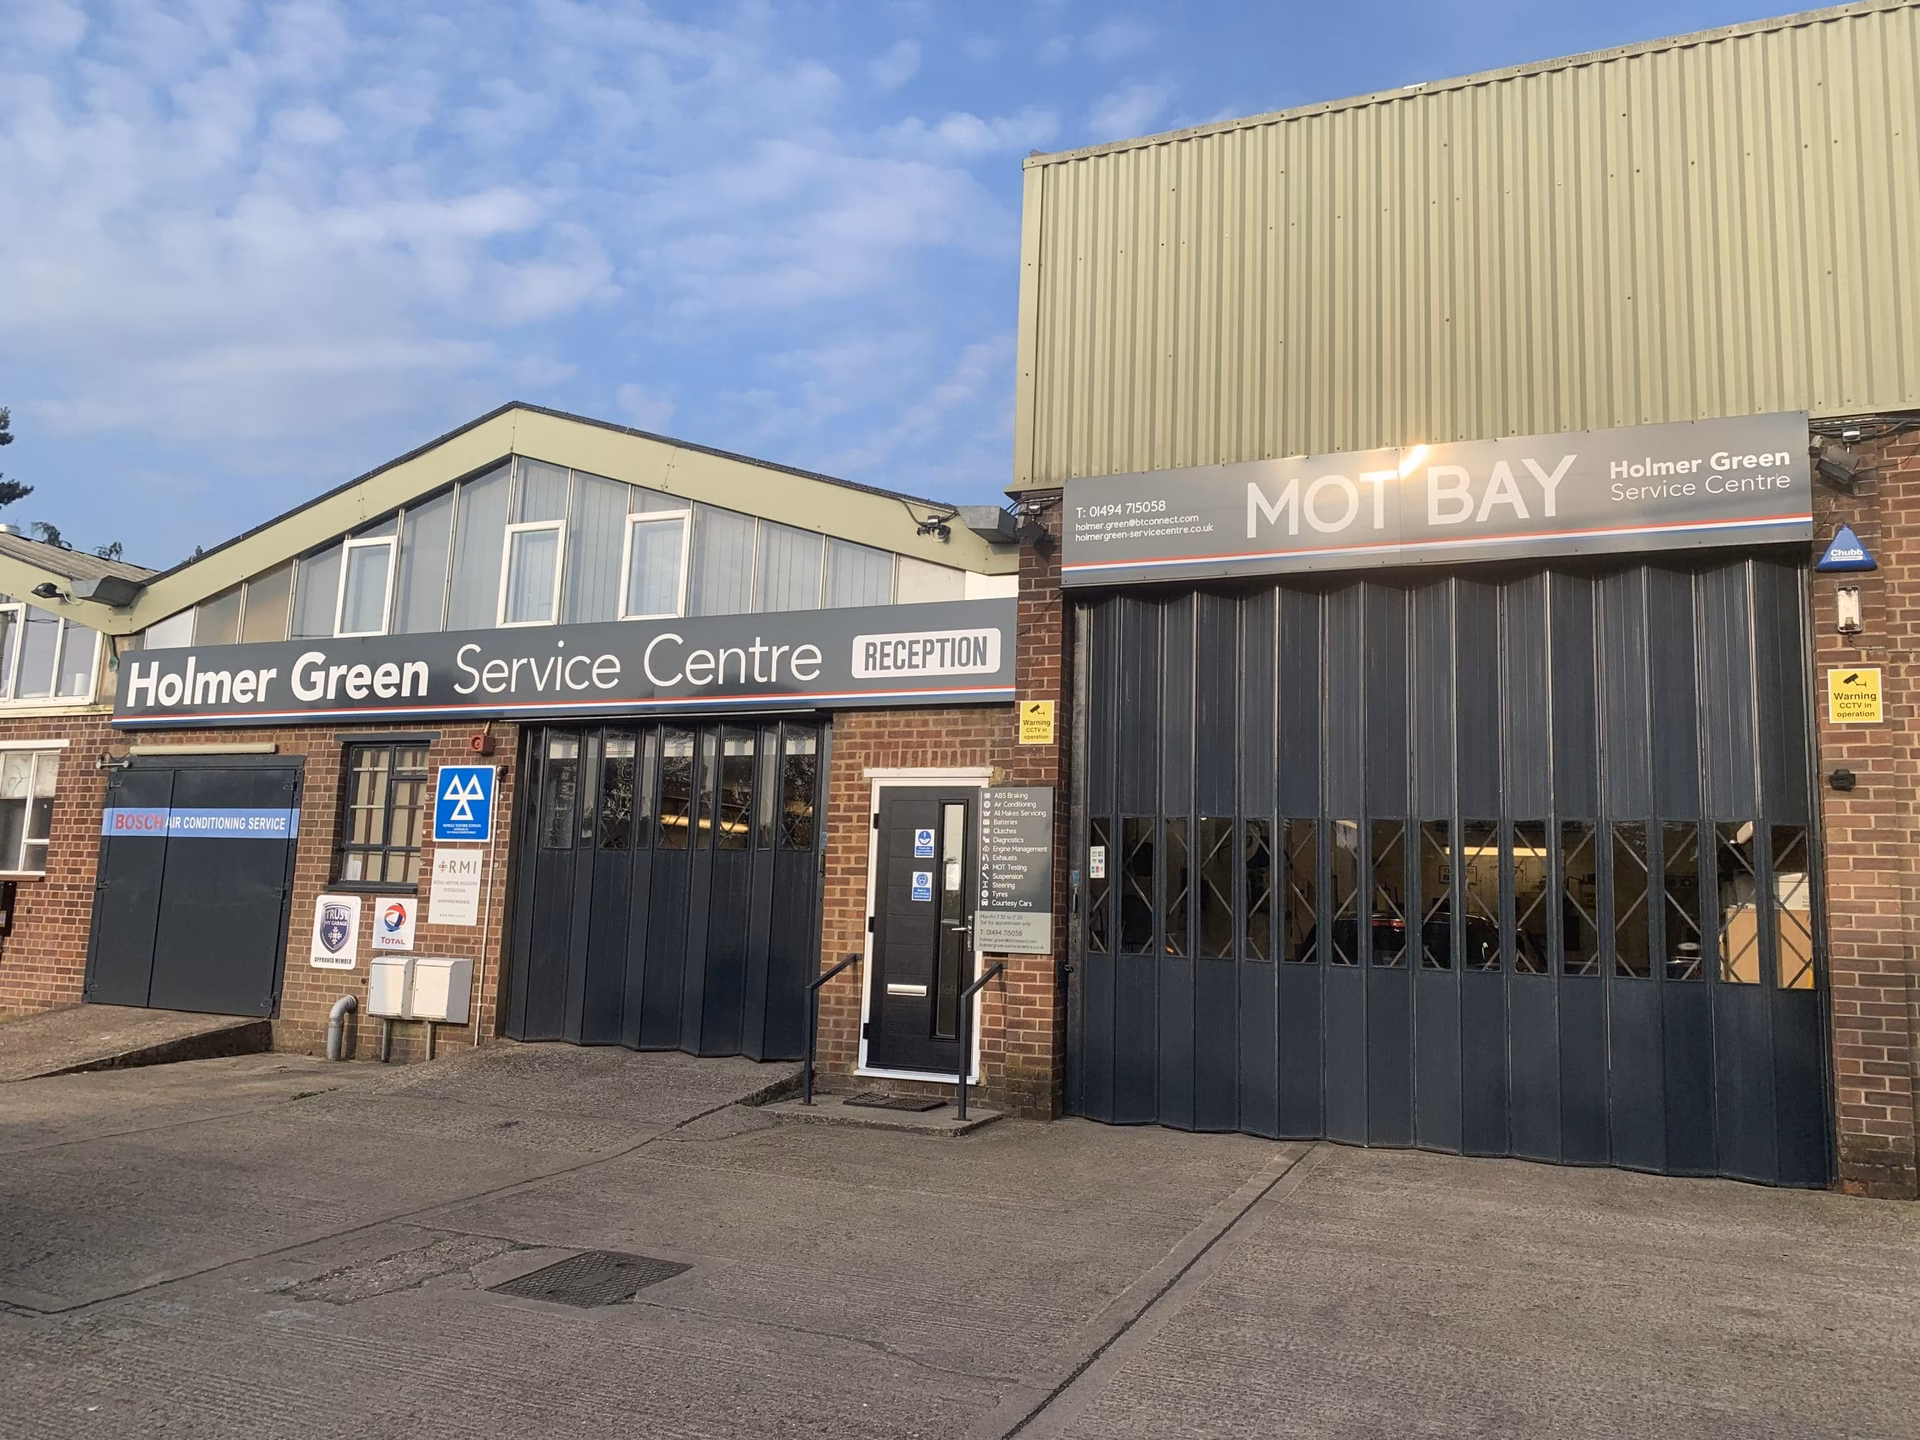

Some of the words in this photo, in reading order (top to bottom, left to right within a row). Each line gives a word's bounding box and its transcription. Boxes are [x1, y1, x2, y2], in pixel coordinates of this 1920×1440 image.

[1610, 457, 1702, 479] Holmer
[1710, 451, 1790, 471] Green
[1247, 470, 1399, 538] MOT
[1427, 454, 1578, 526] BAY
[1611, 480, 1696, 501] Service
[1705, 473, 1791, 494] Centre
[1076, 507, 1086, 518] T:
[1089, 504, 1122, 518] 01494
[1126, 500, 1166, 515] 715058
[1075, 514, 1200, 532] holmer.green@btconnect.com
[1075, 523, 1214, 542] holmergreen-servicecentre.co.uk
[126, 656, 277, 707] Holmer
[291, 651, 429, 702] Green
[453, 640, 621, 694] Service
[643, 633, 822, 687] Centre
[863, 635, 988, 672] RECEPTION
[1834, 692, 1877, 702] Warning
[115, 814, 164, 830] BOSCH
[165, 816, 181, 829] AIR
[184, 816, 246, 830] CONDITIONING
[248, 817, 286, 830] SERVICE
[449, 860, 477, 874] RMI
[1008, 864, 1027, 872] Testing
[992, 882, 1015, 890] Steering
[326, 909, 349, 920] TRUST
